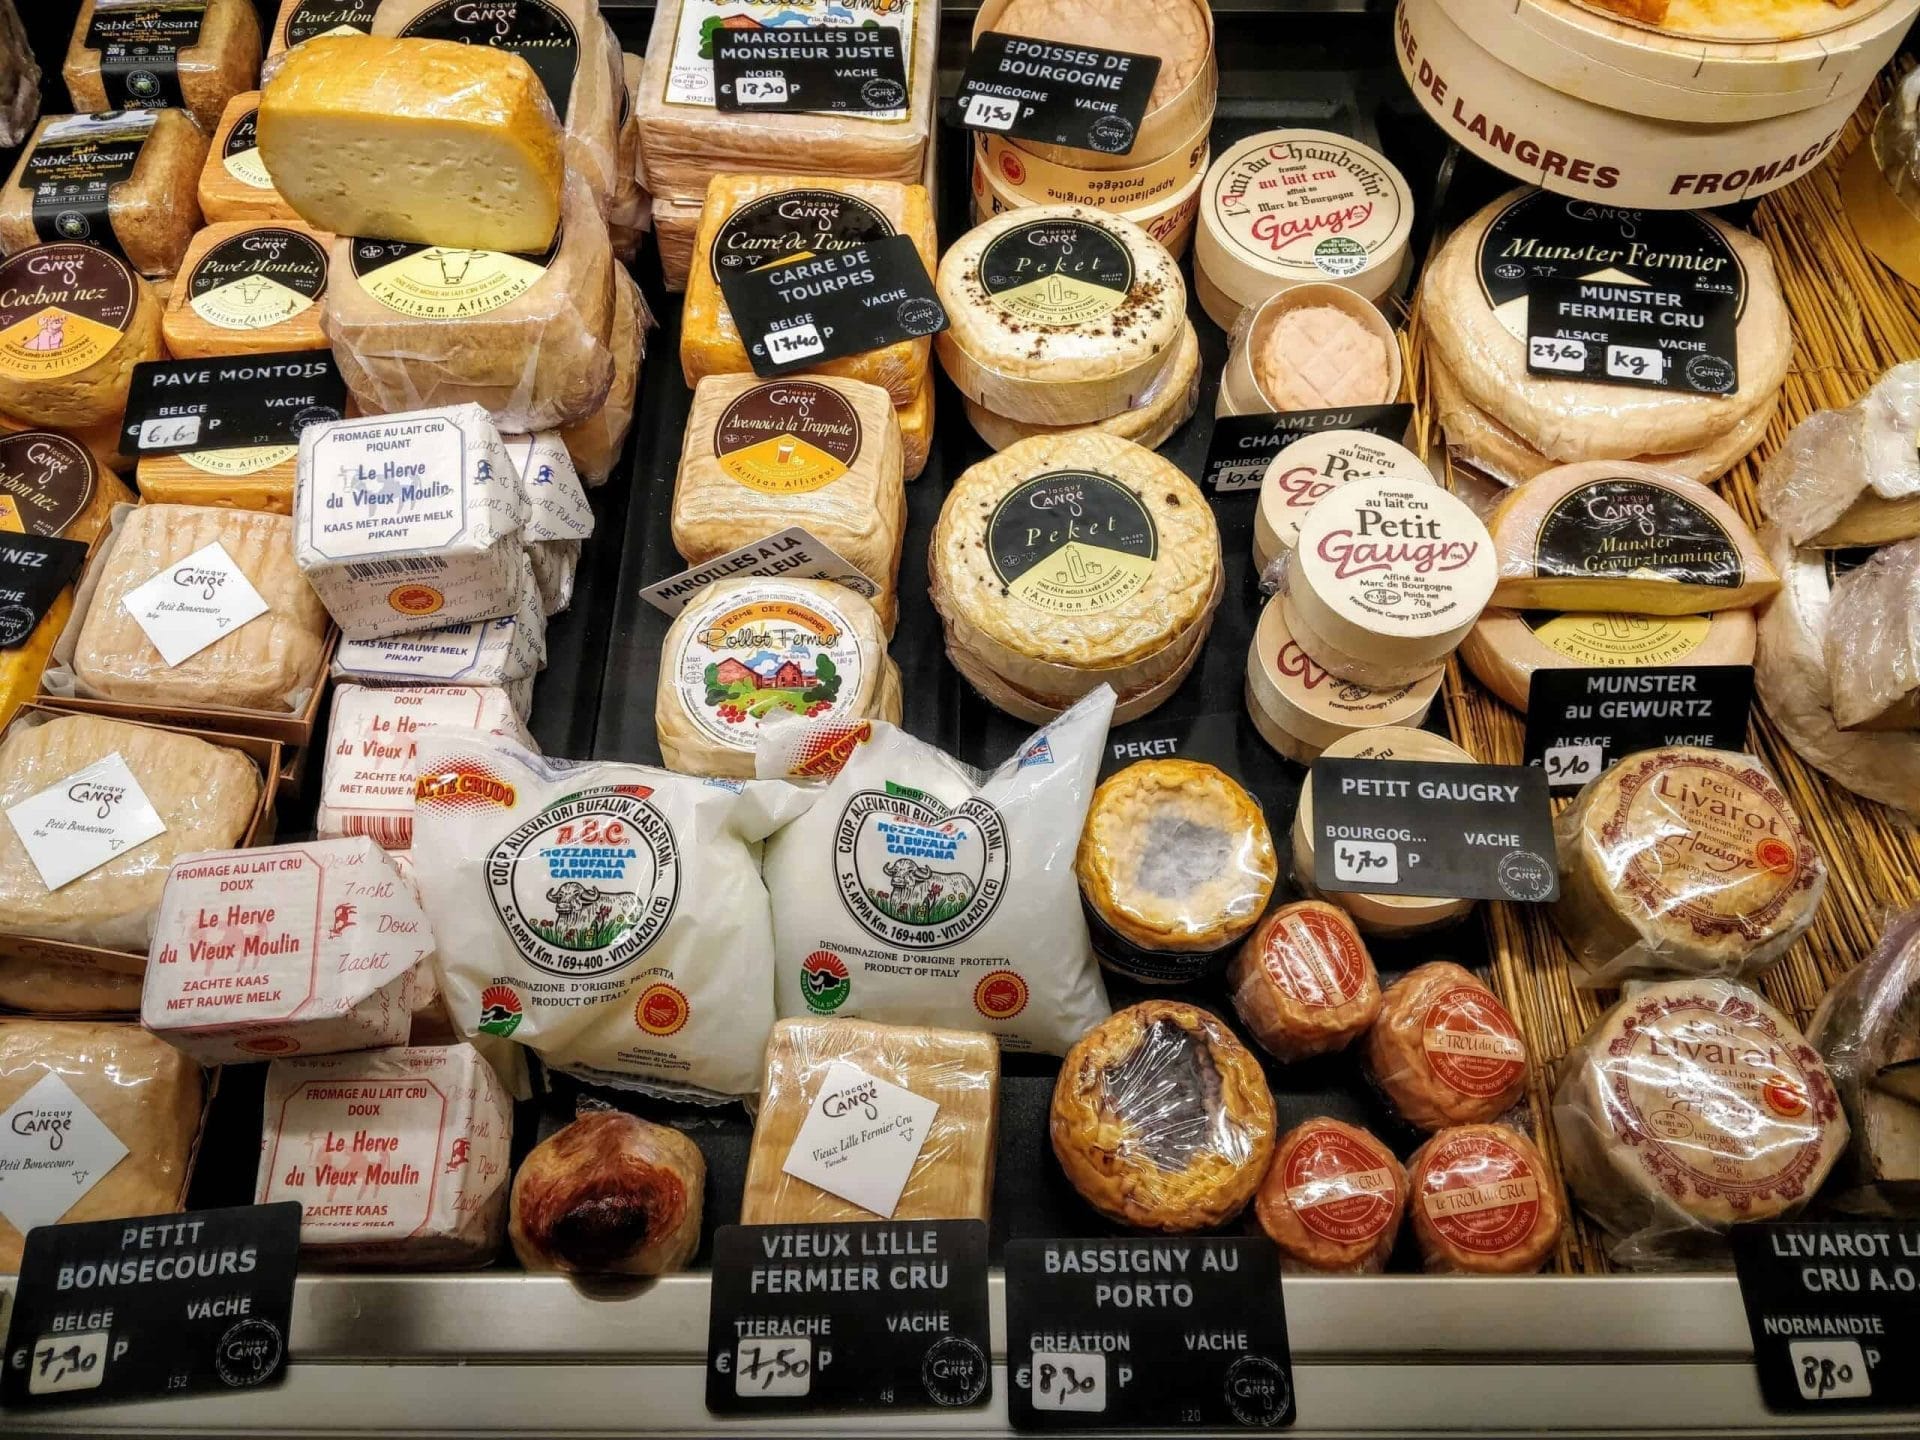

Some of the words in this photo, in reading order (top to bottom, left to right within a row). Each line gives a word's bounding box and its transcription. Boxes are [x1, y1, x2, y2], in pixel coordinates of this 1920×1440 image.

[733, 32, 848, 43] MAROILLES
[854, 32, 879, 42] DE
[720, 48, 829, 59] MONSIEUR
[836, 47, 894, 58] JUSTE
[1005, 40, 1099, 67] EPOISSES
[1104, 56, 1131, 72] DE
[746, 70, 784, 78] NORD
[835, 68, 878, 77] VACHE
[999, 59, 1124, 90] BOURGOGNE
[967, 80, 1048, 102] BOURGOGNE
[1074, 98, 1118, 113] VACHE
[1418, 57, 1448, 106] DE
[1452, 96, 1621, 190] LANGRES
[1669, 128, 1841, 196] FROMAGE
[1014, 257, 1102, 273] Peket
[1500, 238, 1624, 262] Munster
[1626, 243, 1727, 272] Fermier
[202, 260, 244, 273] Pavé
[769, 259, 837, 286] CARRE
[843, 250, 870, 268] DE
[778, 269, 875, 303] TOURPES
[1580, 286, 1683, 307] MUNSTER
[862, 289, 908, 308] VACHE
[770, 313, 814, 331] BELGE
[1559, 303, 1654, 323] FERMIER
[1660, 312, 1704, 328] CRU
[1555, 329, 1609, 343] ALSACE
[1659, 339, 1707, 352] VACHE
[152, 371, 211, 386] PAVE
[219, 362, 328, 381] MONTOIS
[159, 404, 208, 416] BELGE
[265, 396, 315, 407] VACHE
[332, 428, 382, 442] FROMAGE
[384, 427, 398, 436] AU
[400, 426, 423, 434] LAIT
[425, 423, 444, 432] CRU
[786, 415, 798, 431] la
[801, 417, 853, 437] Trappiste
[1274, 417, 1319, 430] AMI
[1322, 414, 1352, 426] DU
[366, 439, 411, 452] PIQUANT
[358, 464, 376, 480] Le
[384, 461, 426, 478] Herve
[326, 494, 343, 508] du
[353, 490, 394, 506] Vieux
[402, 484, 449, 503] Moulin
[1366, 500, 1383, 508] au
[1386, 498, 1405, 508] lait
[1408, 500, 1428, 510] cru
[1378, 491, 1414, 499] Fromage
[324, 522, 354, 533] KAAS
[356, 518, 380, 529] MET
[381, 514, 420, 527] RAUWE
[422, 510, 453, 522] MELK
[1025, 515, 1116, 547] Peket
[1356, 508, 1441, 540] Petit
[368, 528, 408, 540] PIKANT
[1317, 530, 1478, 580] Gaugry
[1597, 537, 1673, 554] Munster
[657, 554, 758, 599] MAROILLES
[761, 547, 776, 560] A
[779, 536, 802, 551] LA
[751, 552, 813, 577] BLEUE
[1587, 675, 1696, 693] MUNSTER
[1565, 704, 1592, 719] au
[1599, 701, 1712, 718] GEWURTZ
[1113, 738, 1178, 759] PEKET
[1555, 737, 1611, 748] ALSACE
[1664, 735, 1714, 746] VACHE
[1341, 778, 1411, 798] PETIT
[1417, 781, 1520, 802] GAUGRY
[1700, 777, 1744, 801] Petit
[1659, 775, 1779, 836] Livarot
[1326, 825, 1428, 842] BOURGOG...
[1464, 832, 1520, 847] VACHE
[887, 845, 956, 861] CAMPANA
[176, 865, 232, 880] FROMAGE
[233, 864, 249, 874] AU
[251, 861, 278, 873] LAIT
[280, 859, 302, 870] CRU
[550, 869, 624, 879] CAMPANA
[220, 880, 254, 892] DOUX
[198, 908, 218, 928] Le
[228, 904, 276, 926] Herve
[159, 944, 177, 964] du
[189, 940, 235, 961] Vieux
[244, 934, 300, 956] Moulin
[819, 940, 898, 962] DENOMINAZIONE
[903, 954, 955, 965] D'ORIGINE
[960, 957, 1011, 966] PROTETTA
[864, 963, 912, 976] PRODUCT
[914, 966, 928, 977] OF
[930, 968, 960, 978] ITALY
[182, 978, 232, 992] ZACHTE
[236, 974, 269, 986] KAAS
[166, 998, 192, 1010] MET
[196, 994, 244, 1008] RAUWE
[246, 990, 282, 1004] MELK
[306, 1089, 360, 1100] FROMAGE
[362, 1089, 377, 1099] AU
[380, 1088, 403, 1098] LAIT
[405, 1088, 427, 1098] CRU
[348, 1105, 380, 1116] DOUX
[325, 1131, 345, 1153] Le
[354, 1131, 399, 1151] Herve
[812, 1144, 838, 1162] Vieux
[840, 1134, 859, 1151] Lille
[861, 1123, 894, 1143] Fermier
[895, 1115, 913, 1128] Cru
[285, 1166, 304, 1187] du
[315, 1164, 359, 1186] Vieux
[366, 1164, 420, 1185] Moulin
[306, 1206, 353, 1217] ZACHTE
[356, 1206, 388, 1216] KAAS
[122, 1222, 205, 1249] PETIT
[762, 1234, 851, 1257] VIEUX
[861, 1231, 938, 1256] LILLE
[1771, 1233, 1891, 1257] LIVAROT
[56, 1248, 257, 1290] BONSECOURS
[1044, 1249, 1191, 1273] BASSIGNY
[1202, 1248, 1239, 1272] AU
[750, 1267, 881, 1293] FERMIER
[889, 1265, 949, 1289] CRU
[1802, 1268, 1861, 1292] CRU
[1095, 1284, 1194, 1308] PORTO
[186, 1298, 251, 1320] VACHE
[52, 1312, 114, 1332] BELGE
[734, 1319, 832, 1337] TIERACHE
[886, 1315, 950, 1332] VACHE
[1763, 1318, 1885, 1335] NORMANDIE
[1030, 1334, 1131, 1352] CREATION
[1184, 1334, 1248, 1350] VACHE
[739, 1347, 809, 1390] 7,50
